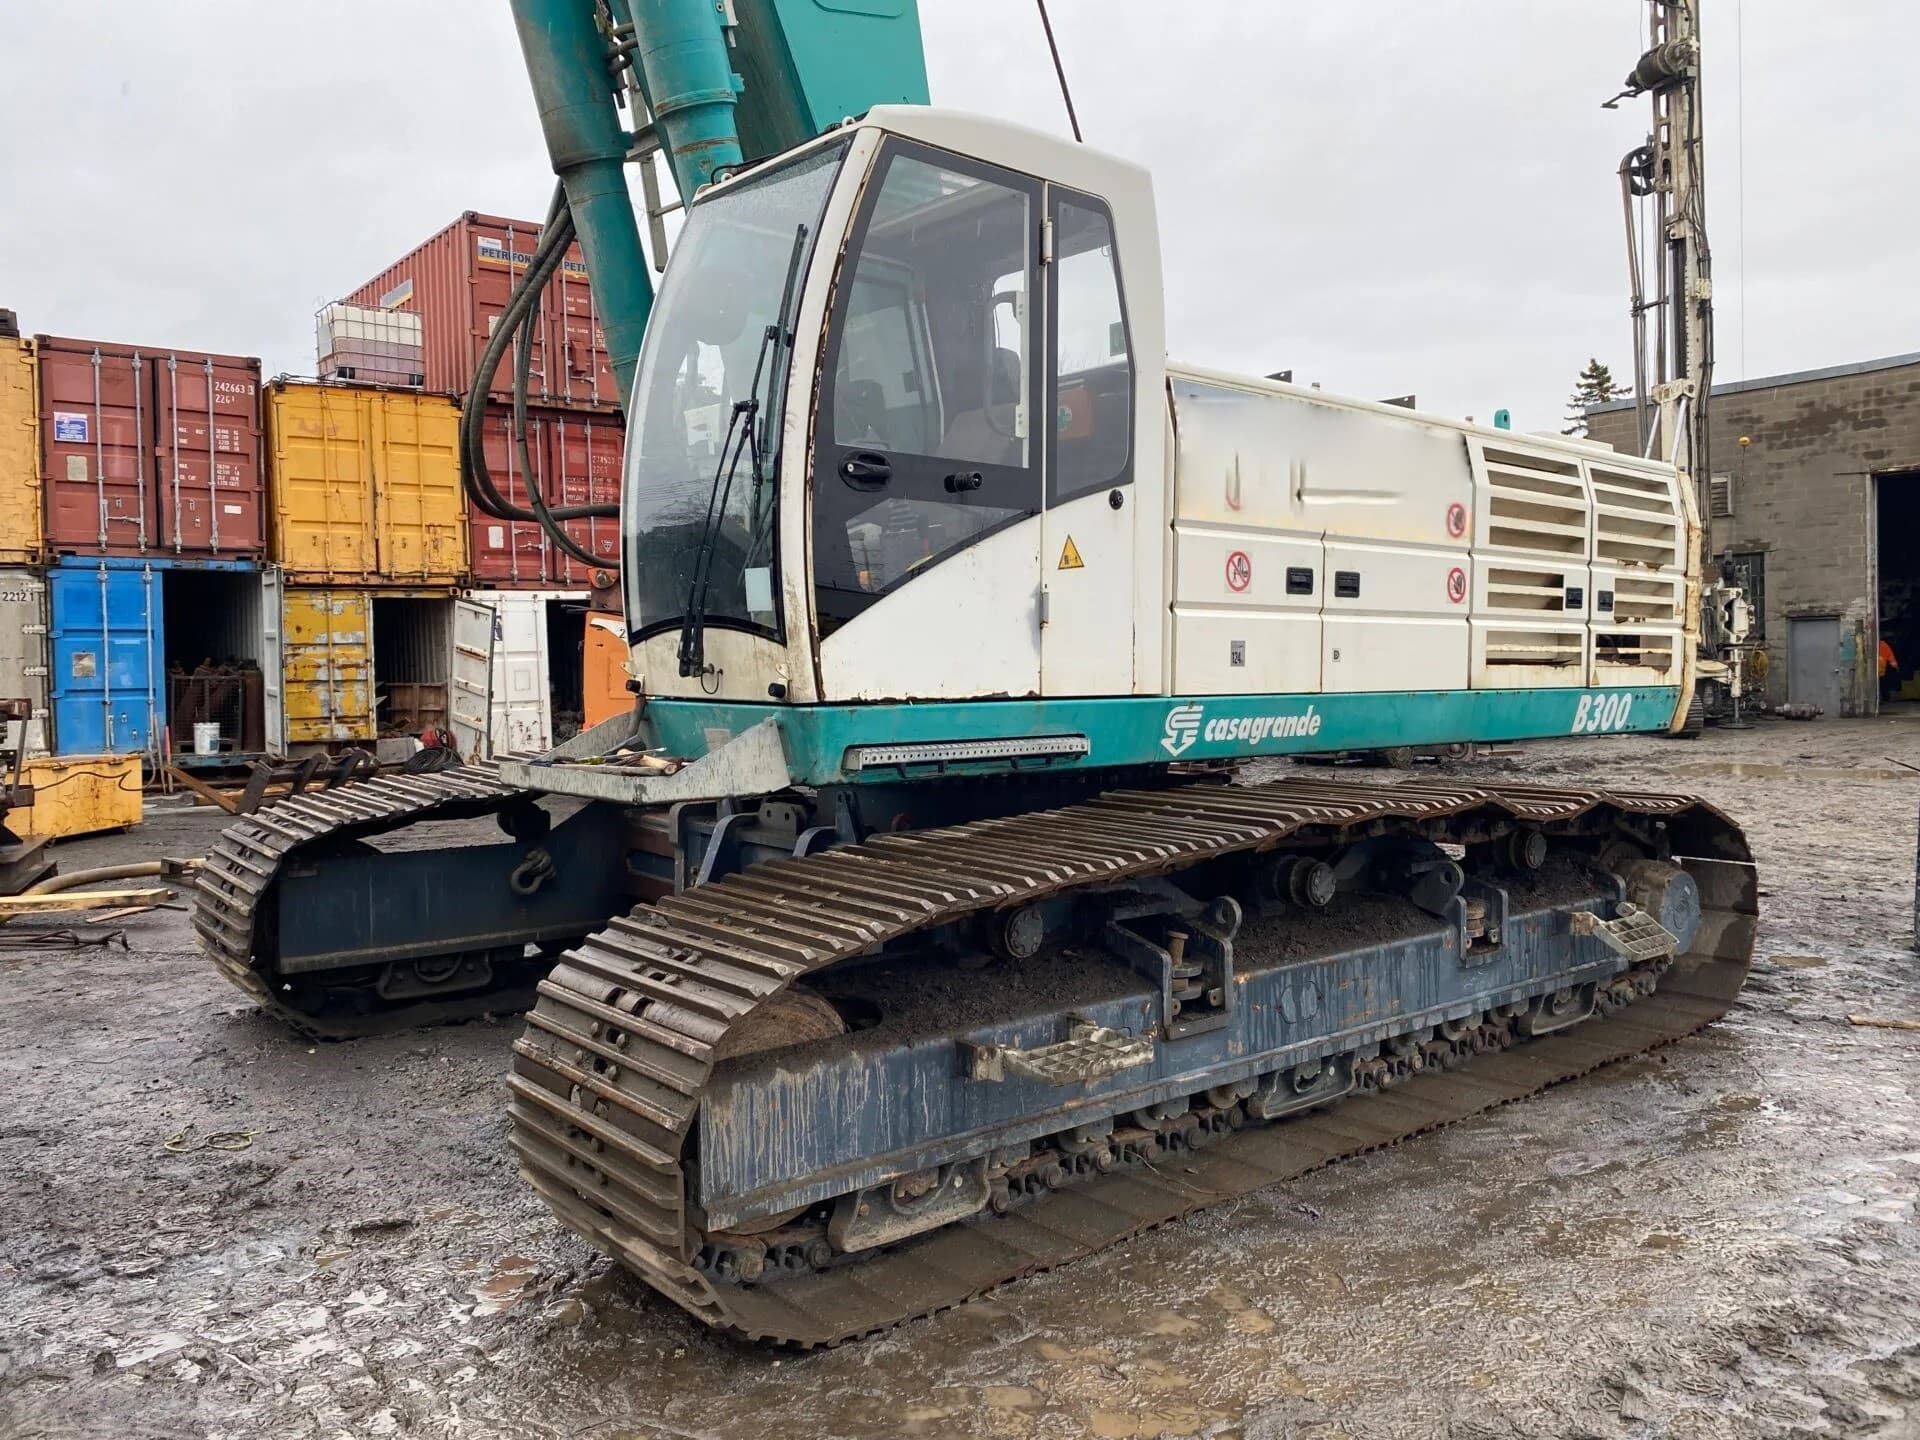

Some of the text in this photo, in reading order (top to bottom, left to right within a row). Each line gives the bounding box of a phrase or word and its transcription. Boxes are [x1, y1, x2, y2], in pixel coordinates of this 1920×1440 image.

[481, 247, 531, 264] PETRIFON
[215, 382, 245, 394] 242663
[2, 591, 34, 602] 2212 1
[1571, 692, 1633, 733] B300
[1204, 704, 1321, 745] casagrande
